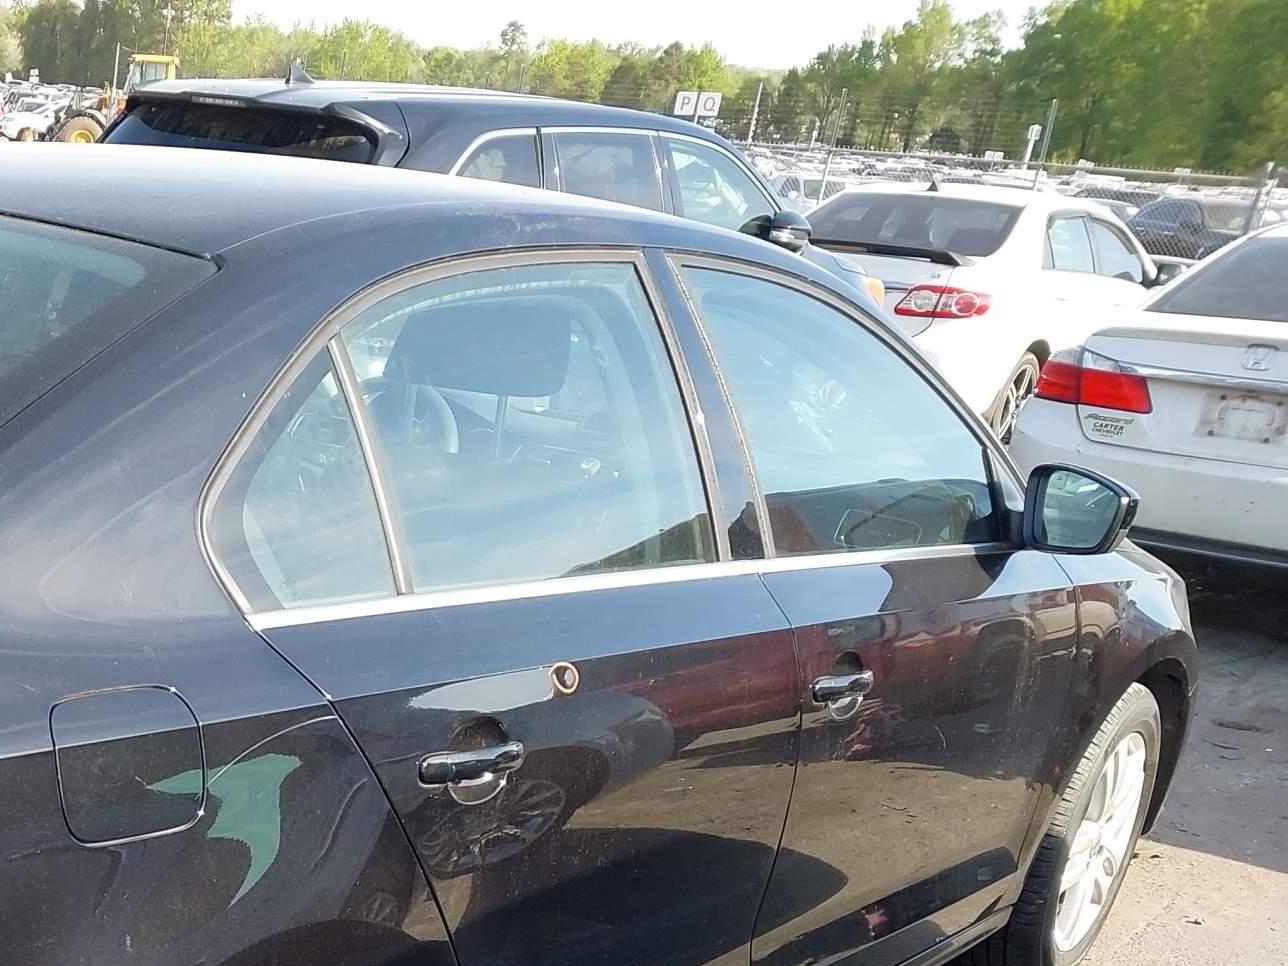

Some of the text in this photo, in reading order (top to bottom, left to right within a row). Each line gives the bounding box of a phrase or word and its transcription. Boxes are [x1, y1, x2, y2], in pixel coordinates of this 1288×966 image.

[680, 95, 692, 111] P
[703, 96, 716, 112] Q
[1093, 422, 1124, 431] CARTER
